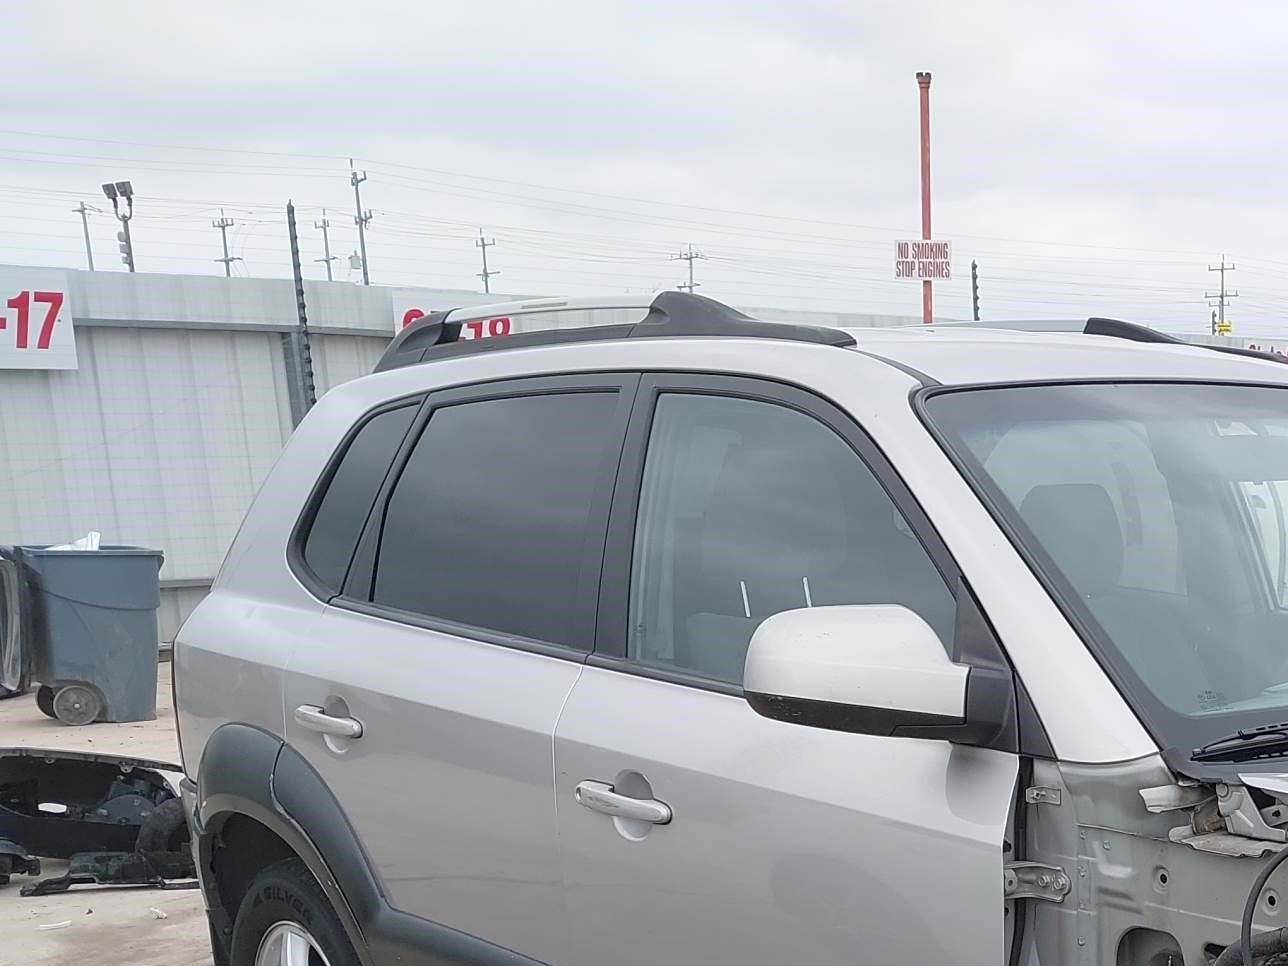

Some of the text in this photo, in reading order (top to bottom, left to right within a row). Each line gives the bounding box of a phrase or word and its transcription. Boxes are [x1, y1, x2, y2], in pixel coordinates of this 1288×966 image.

[897, 242, 949, 260] NO SMOKING
[896, 260, 950, 278] STOP ENGINES
